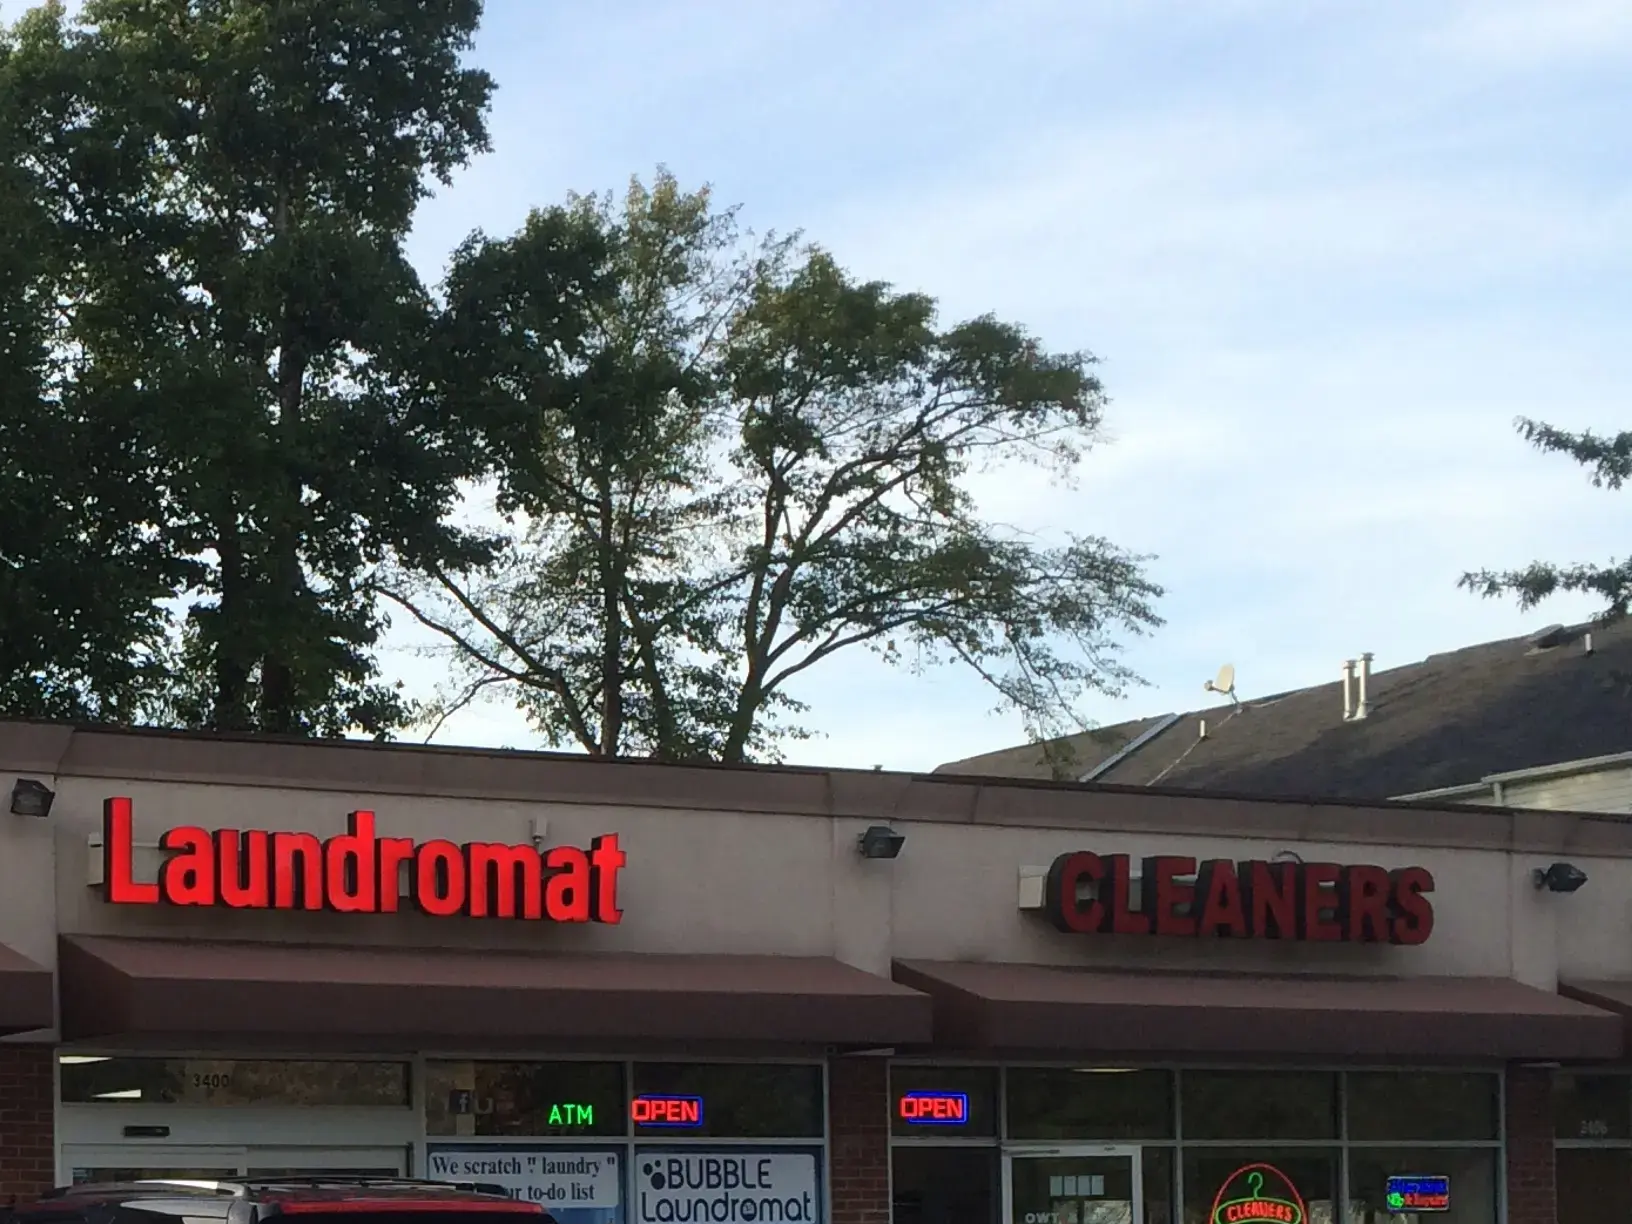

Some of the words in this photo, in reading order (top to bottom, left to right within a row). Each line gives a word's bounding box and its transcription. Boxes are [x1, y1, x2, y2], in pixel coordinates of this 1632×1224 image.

[102, 796, 624, 926] Laundromat
[1047, 850, 1435, 946] CLEANERS
[193, 1072, 230, 1089] 3400
[548, 1104, 593, 1125] ATM
[631, 1099, 699, 1122] OPEN
[900, 1097, 963, 1119] OPEN
[432, 1156, 459, 1175] We
[464, 1156, 521, 1175] scratch
[542, 1156, 601, 1177] laundry
[668, 1159, 772, 1190] BUBBLE
[528, 1182, 566, 1201] to-do
[571, 1183, 595, 1200] list
[641, 1191, 811, 1223] Laundromat
[1227, 1201, 1293, 1222] CLEANERS
